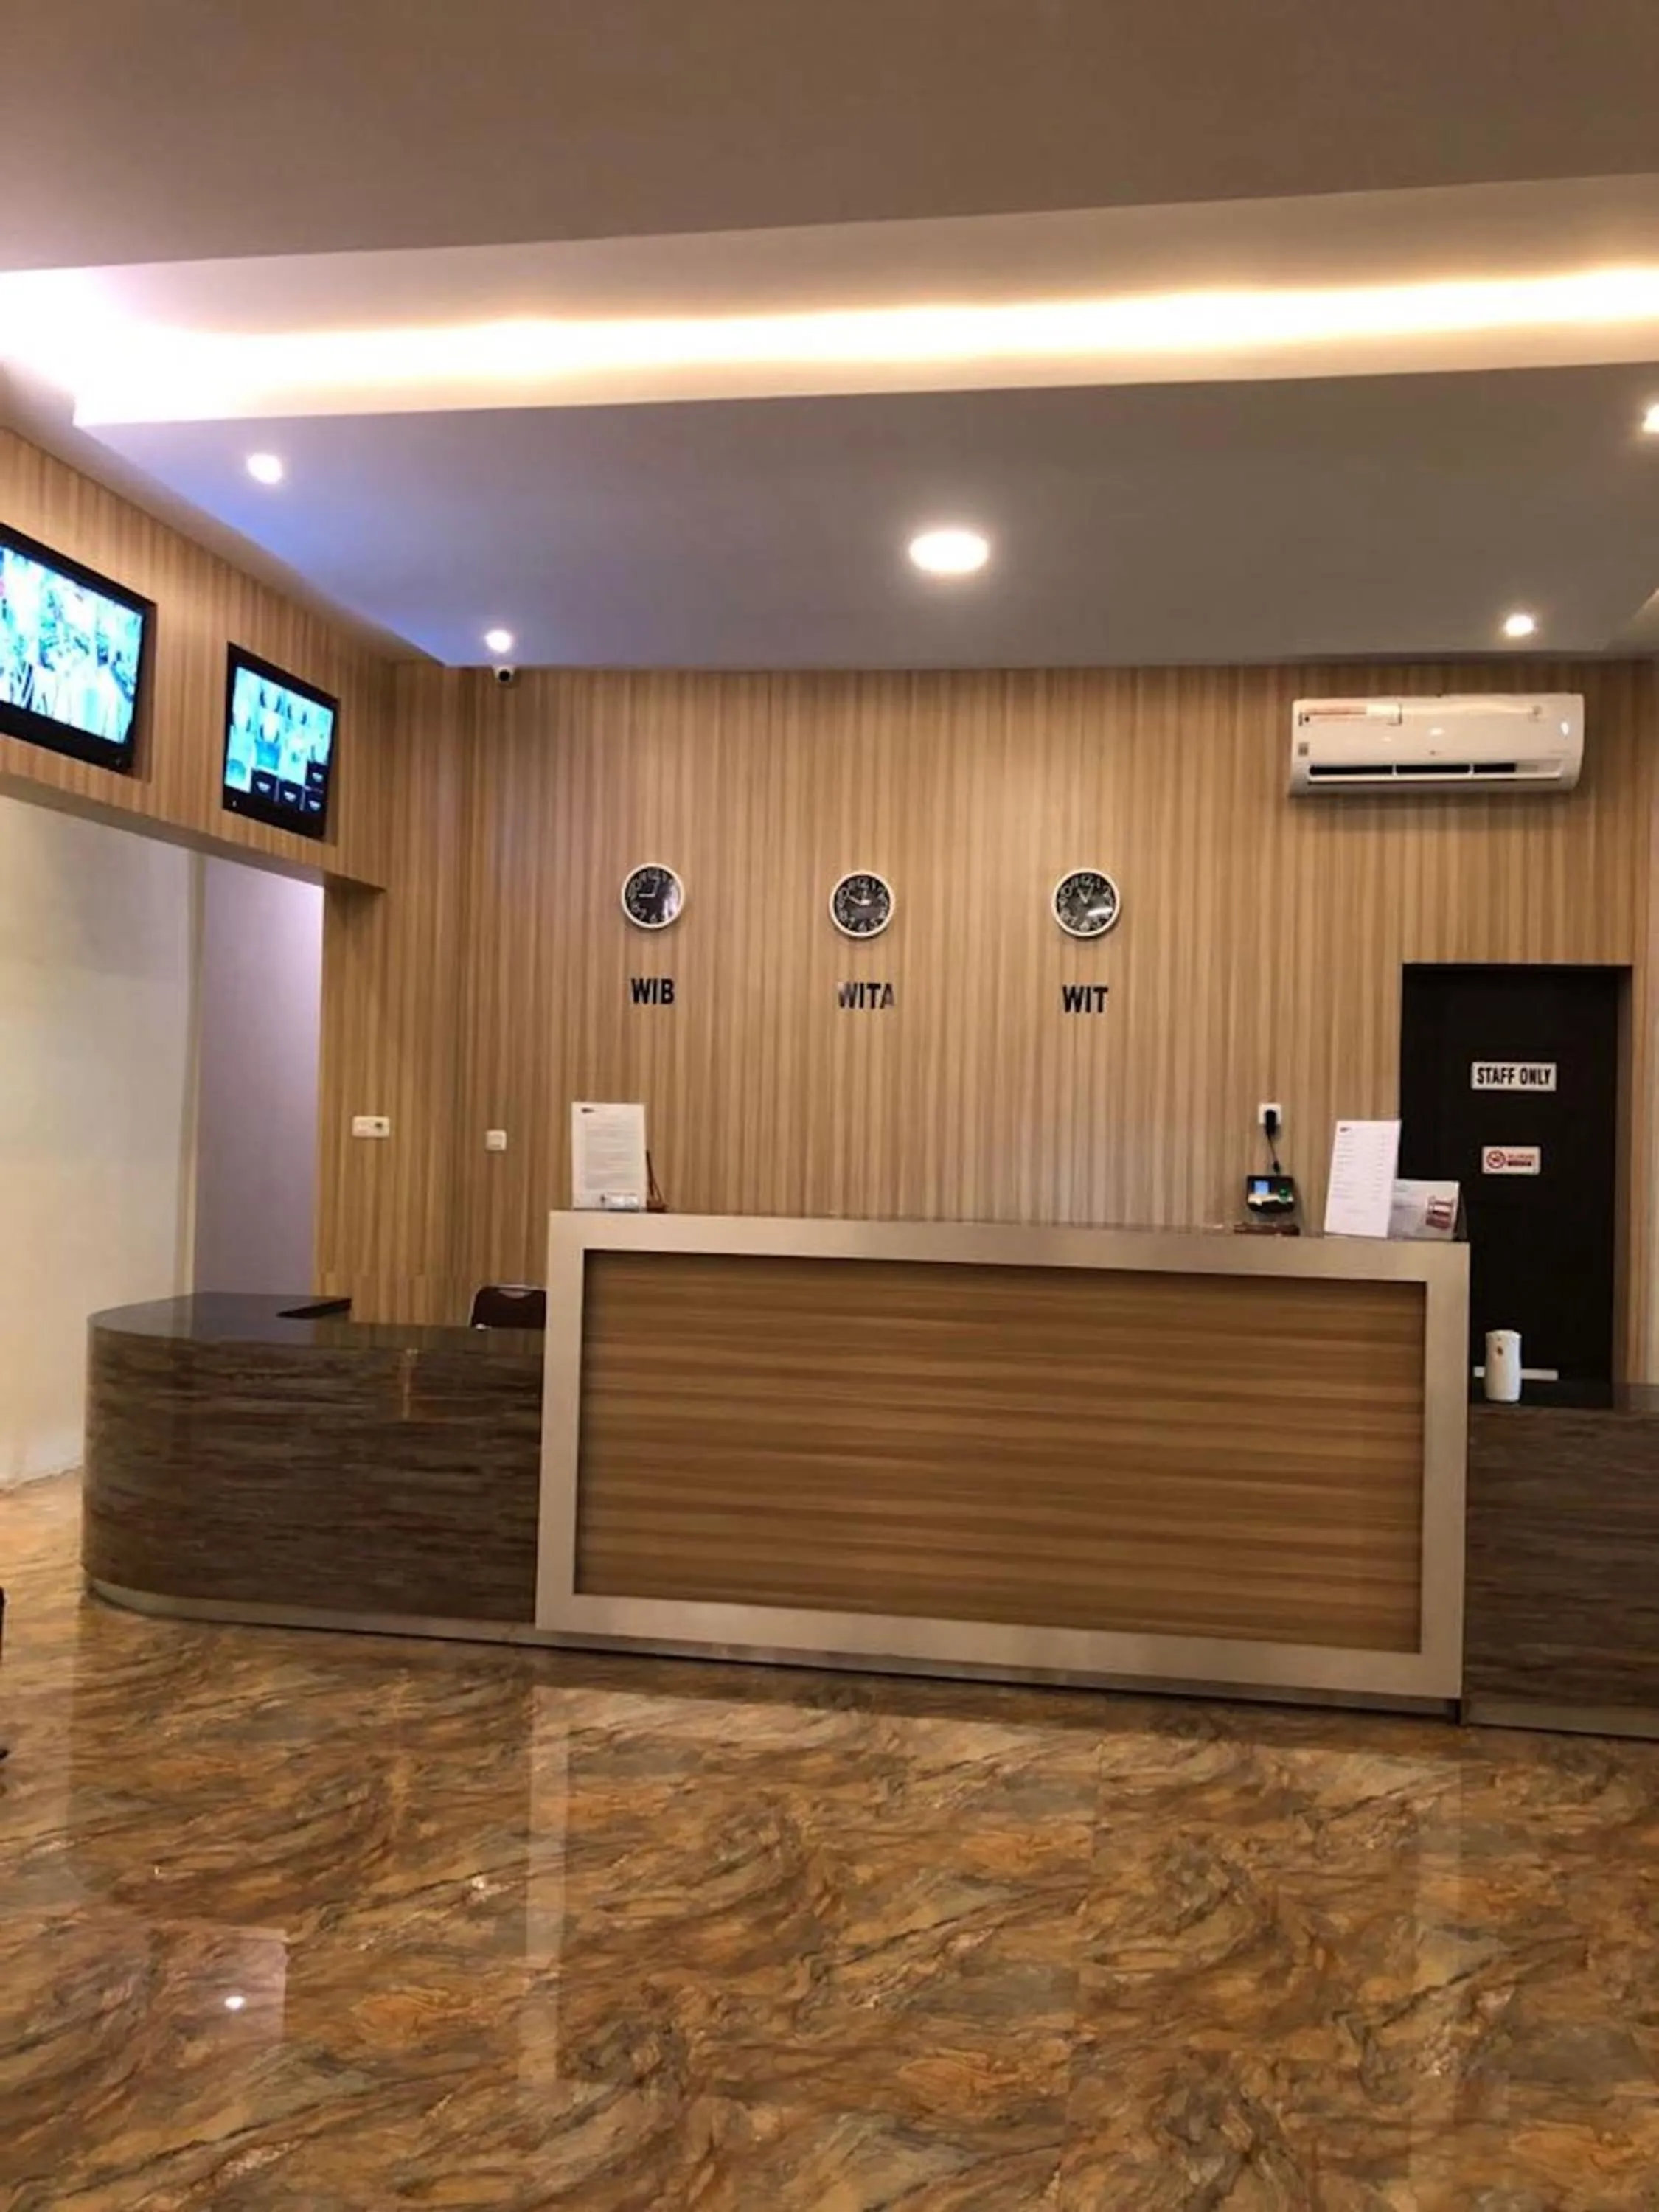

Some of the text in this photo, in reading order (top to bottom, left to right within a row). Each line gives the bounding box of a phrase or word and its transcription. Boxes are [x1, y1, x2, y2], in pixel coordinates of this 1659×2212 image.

[631, 978, 675, 1004] WIB
[838, 982, 894, 1009] WITA
[1062, 985, 1108, 1013] WIT
[1477, 1067, 1551, 1085] STAFF ONLY
